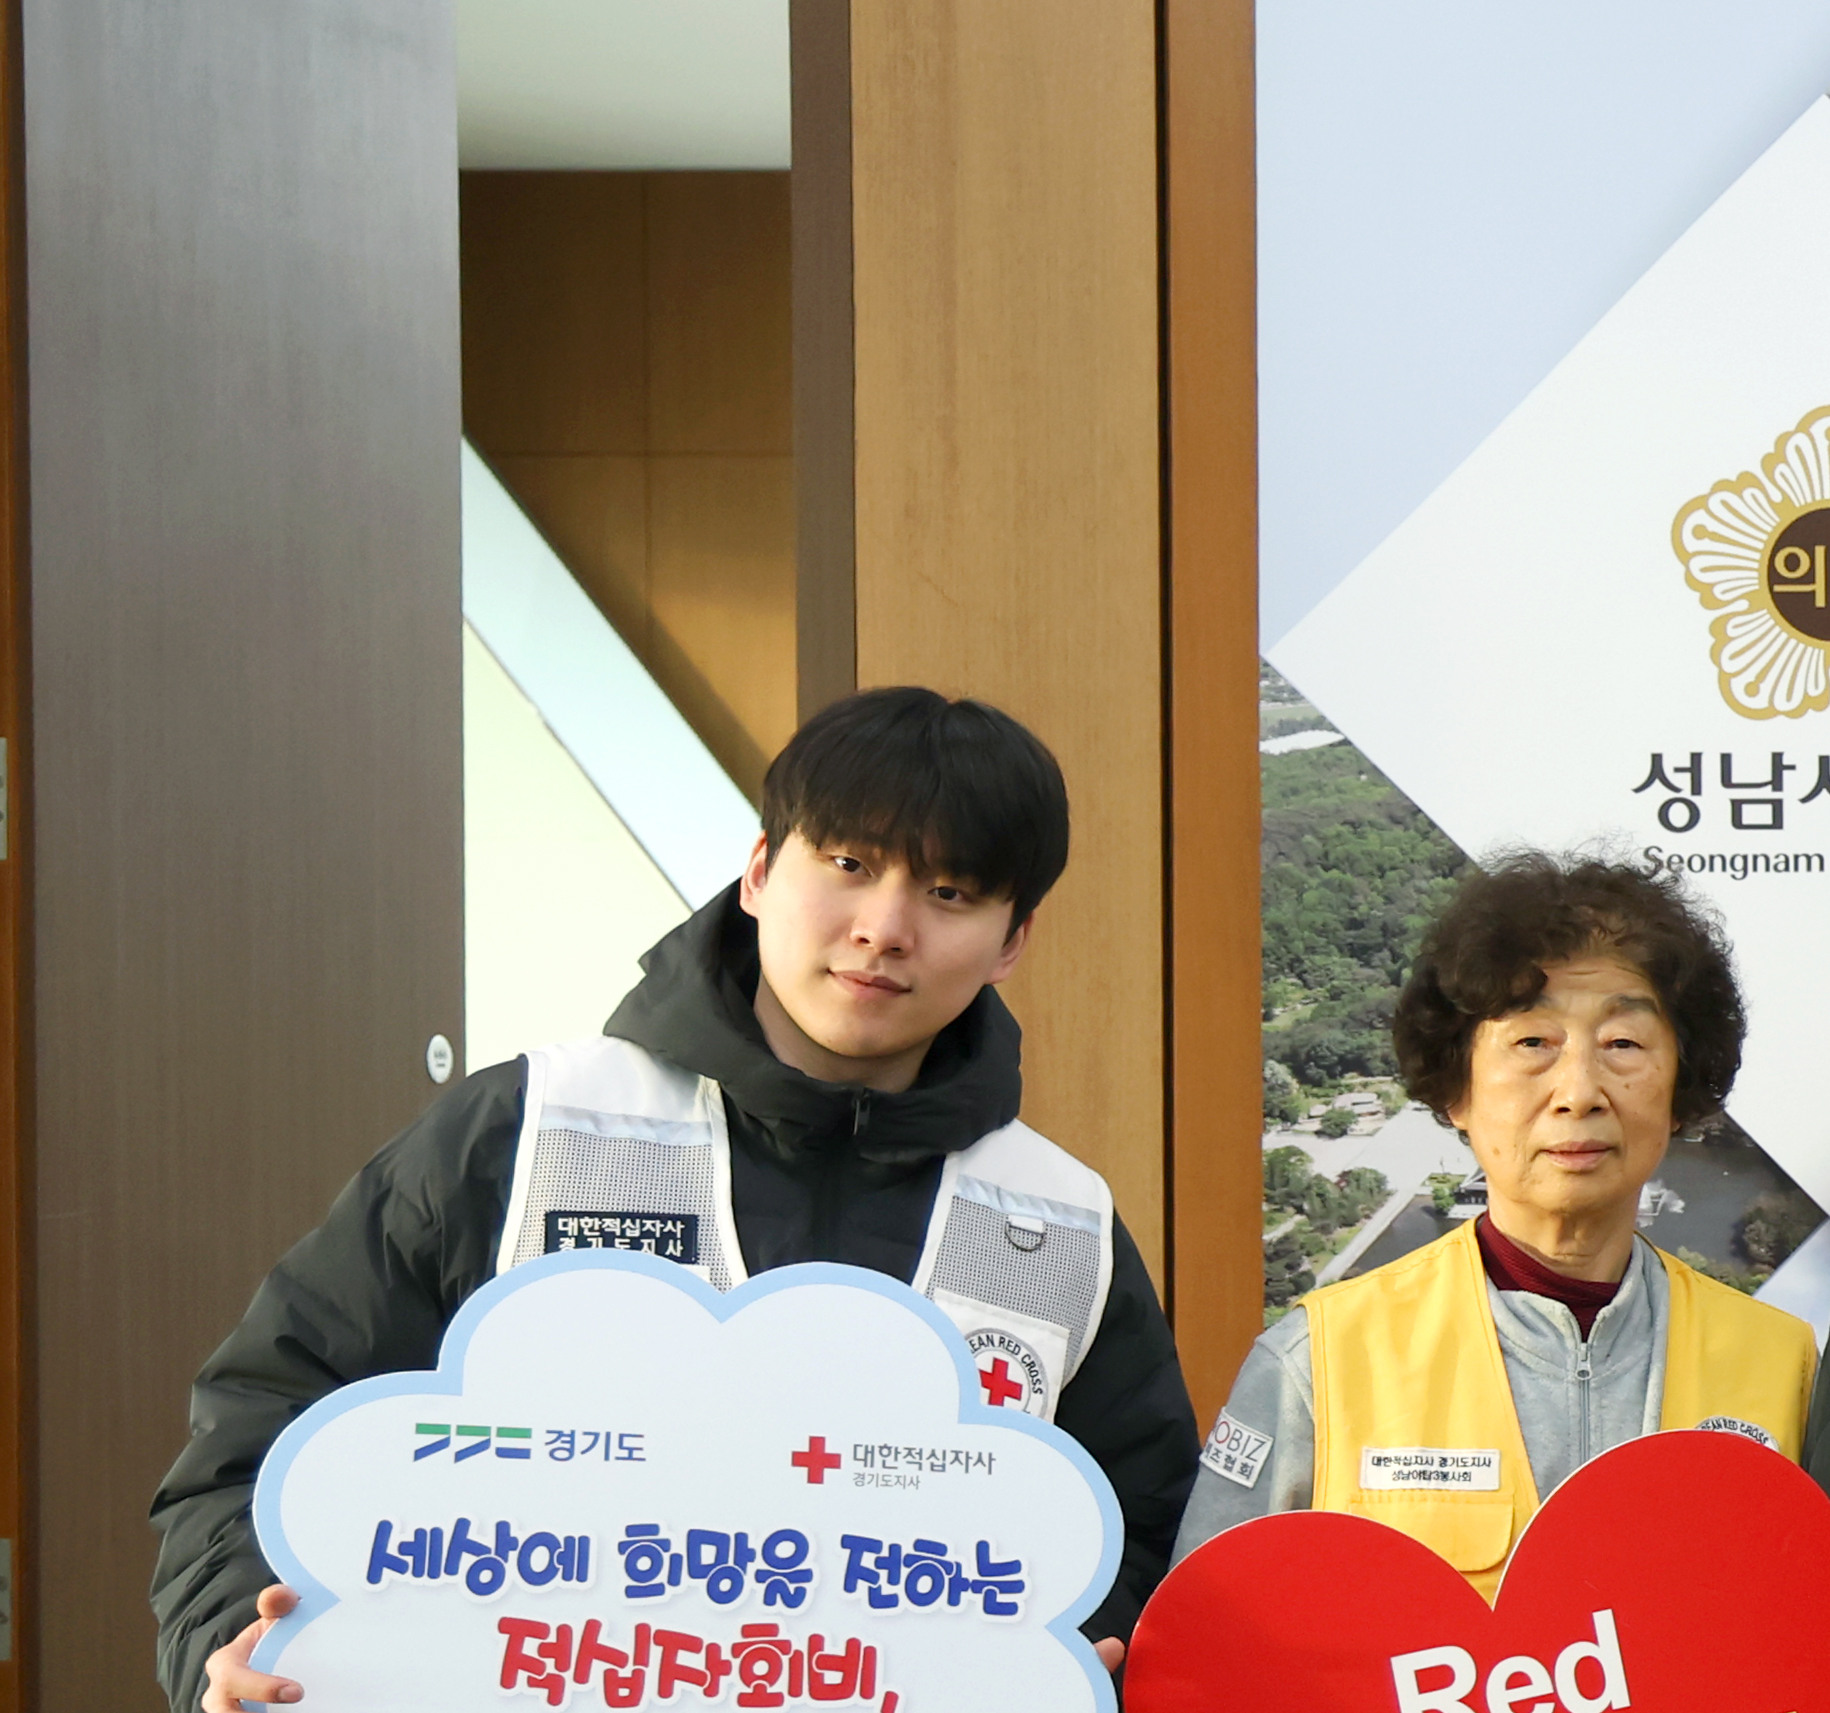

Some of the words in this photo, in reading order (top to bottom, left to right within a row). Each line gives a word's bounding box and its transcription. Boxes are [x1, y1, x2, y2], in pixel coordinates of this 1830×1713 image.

[1642, 845, 1825, 881] Seongnam
[558, 1216, 685, 1238] 대한적십자사
[998, 1336, 1022, 1356] RED
[1021, 1353, 1043, 1395] CROSS
[544, 1429, 646, 1464] 경기도
[853, 1442, 996, 1475] 대한적십자사
[1212, 1421, 1266, 1463] OBIZ
[853, 1473, 921, 1490] 경기도지사
[366, 1519, 590, 1597] 세상에
[618, 1524, 813, 1605] 희망을
[840, 1535, 1026, 1616] 전하는
